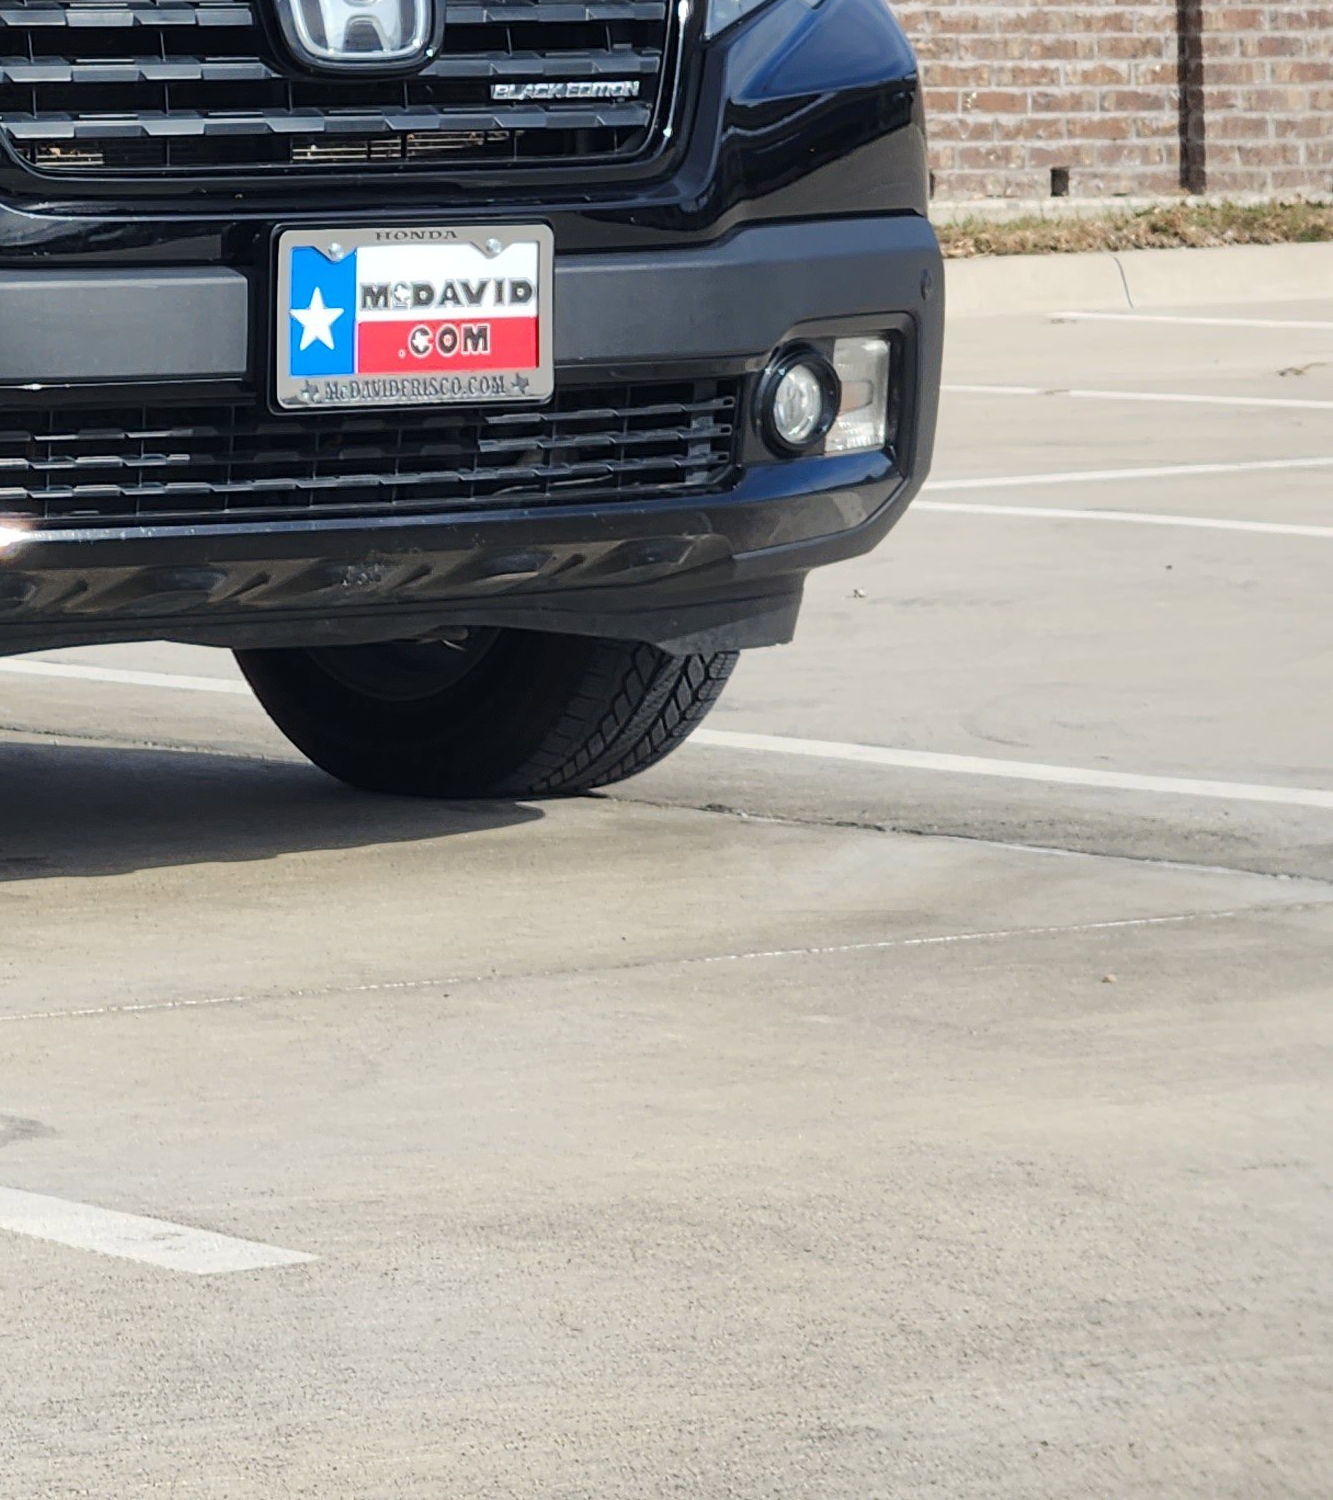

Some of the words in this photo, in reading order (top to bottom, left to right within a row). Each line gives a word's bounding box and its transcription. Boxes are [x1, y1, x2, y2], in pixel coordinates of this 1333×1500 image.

[492, 83, 565, 100] BLACK
[565, 81, 640, 98] EDITION
[376, 229, 459, 241] HONDA
